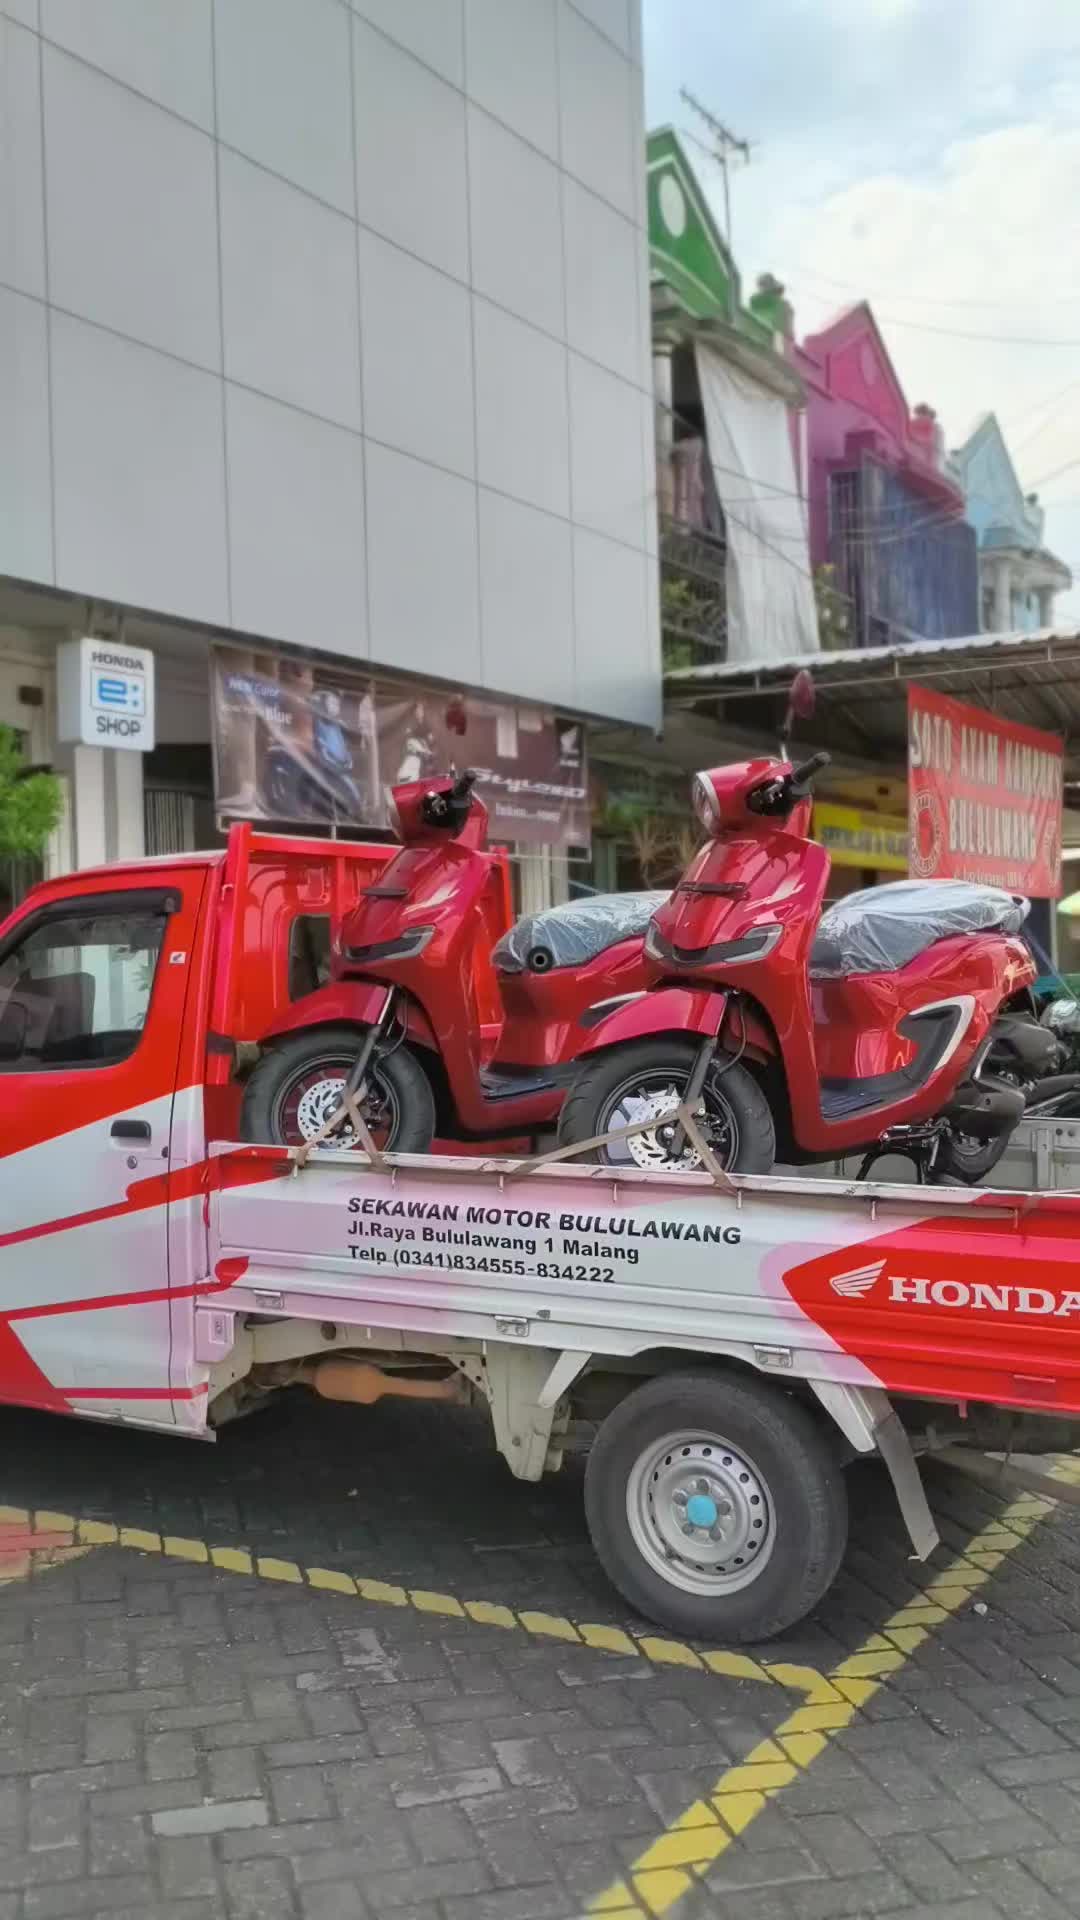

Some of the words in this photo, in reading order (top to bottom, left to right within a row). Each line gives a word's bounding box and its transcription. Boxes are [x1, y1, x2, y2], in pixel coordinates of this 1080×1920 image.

[92, 652, 144, 671] HONDA
[96, 715, 141, 736] SHOP
[347, 1197, 459, 1222] SEKAWAN
[466, 1206, 551, 1229] MOTOR
[559, 1213, 742, 1245] BULULAWANG
[347, 1220, 416, 1243] Jl.Raya
[422, 1226, 537, 1256] Bululawang
[544, 1237, 554, 1253] 1
[563, 1239, 639, 1264] Malang
[347, 1244, 387, 1264] Telp
[393, 1248, 615, 1284] (0341)834555-834222
